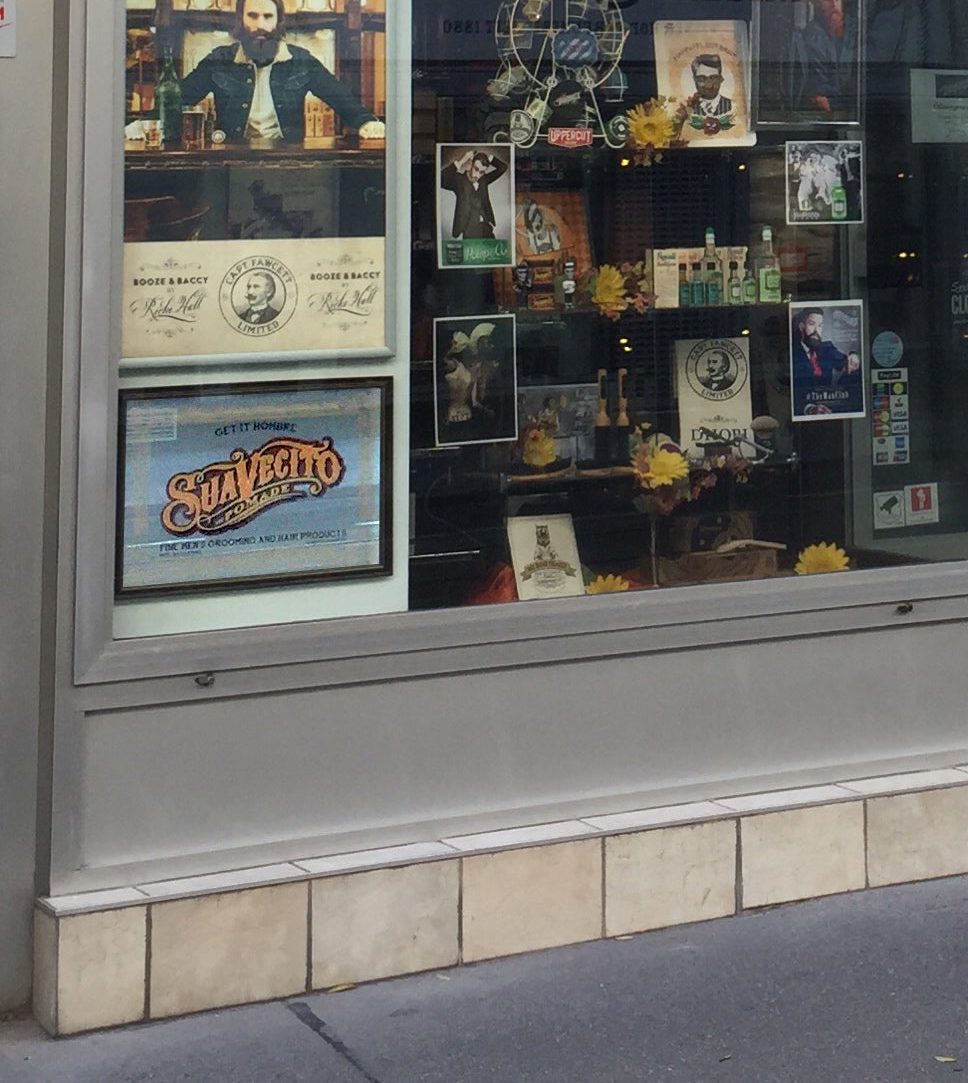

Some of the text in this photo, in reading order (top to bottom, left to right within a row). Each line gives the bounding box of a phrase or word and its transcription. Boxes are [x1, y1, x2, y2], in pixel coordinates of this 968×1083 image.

[550, 130, 591, 141] UPPERCUT
[225, 258, 293, 285] CAPT FAWCETT
[310, 272, 341, 280] BOOZE
[351, 271, 381, 279] BACCY
[133, 278, 166, 286] BOOZE
[177, 276, 209, 285] BACCY
[237, 320, 279, 334] LIMITED
[701, 389, 734, 399] LIMITED
[215, 423, 237, 437] GET
[240, 421, 250, 431] IT
[161, 436, 346, 535] SUAVECITO
[207, 536, 256, 548] GROOMING
[258, 534, 276, 544] AND
[300, 529, 347, 540] PRODUCTS
